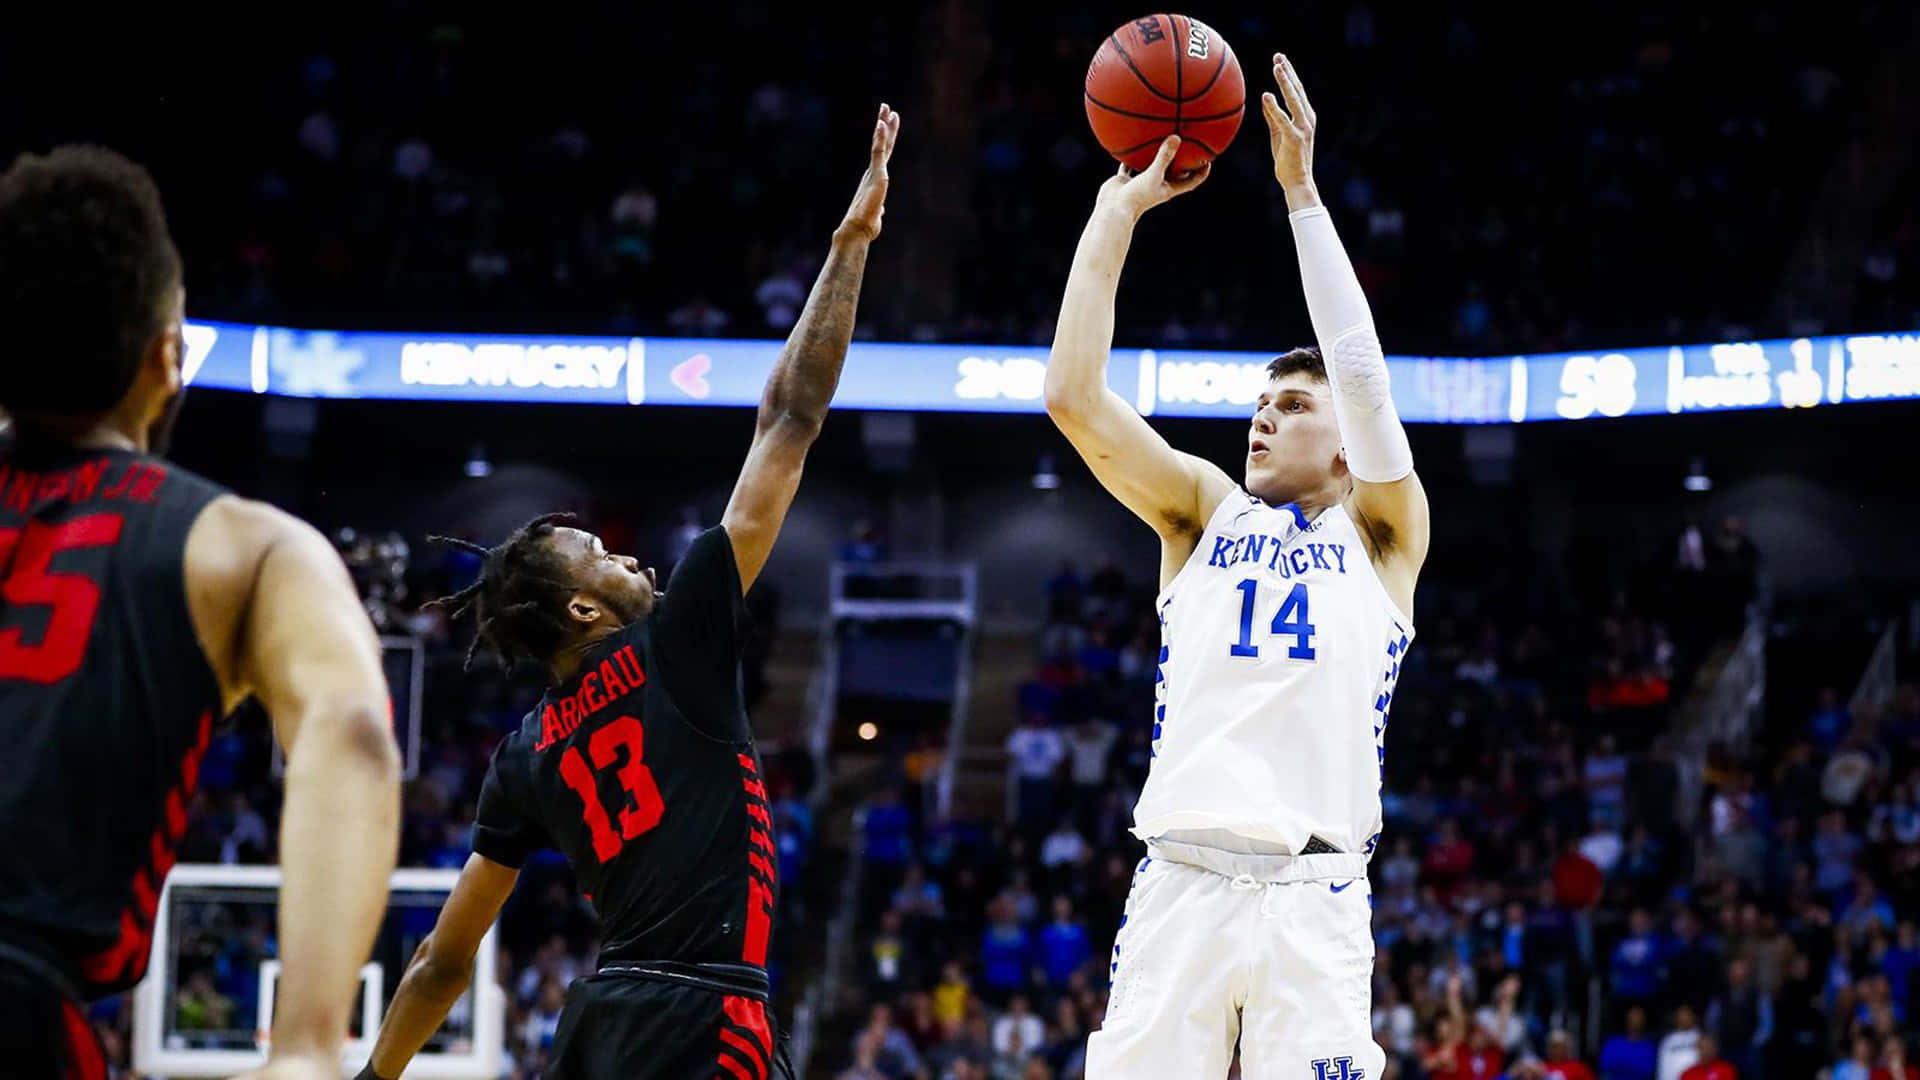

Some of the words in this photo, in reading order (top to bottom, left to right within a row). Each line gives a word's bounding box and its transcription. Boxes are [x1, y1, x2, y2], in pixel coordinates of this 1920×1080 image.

[400, 342, 628, 389] KENTUCKY
[104, 462, 165, 503] JR
[1209, 534, 1347, 579] KENTUCKY
[1230, 577, 1316, 661] 14
[559, 715, 666, 864] 13
